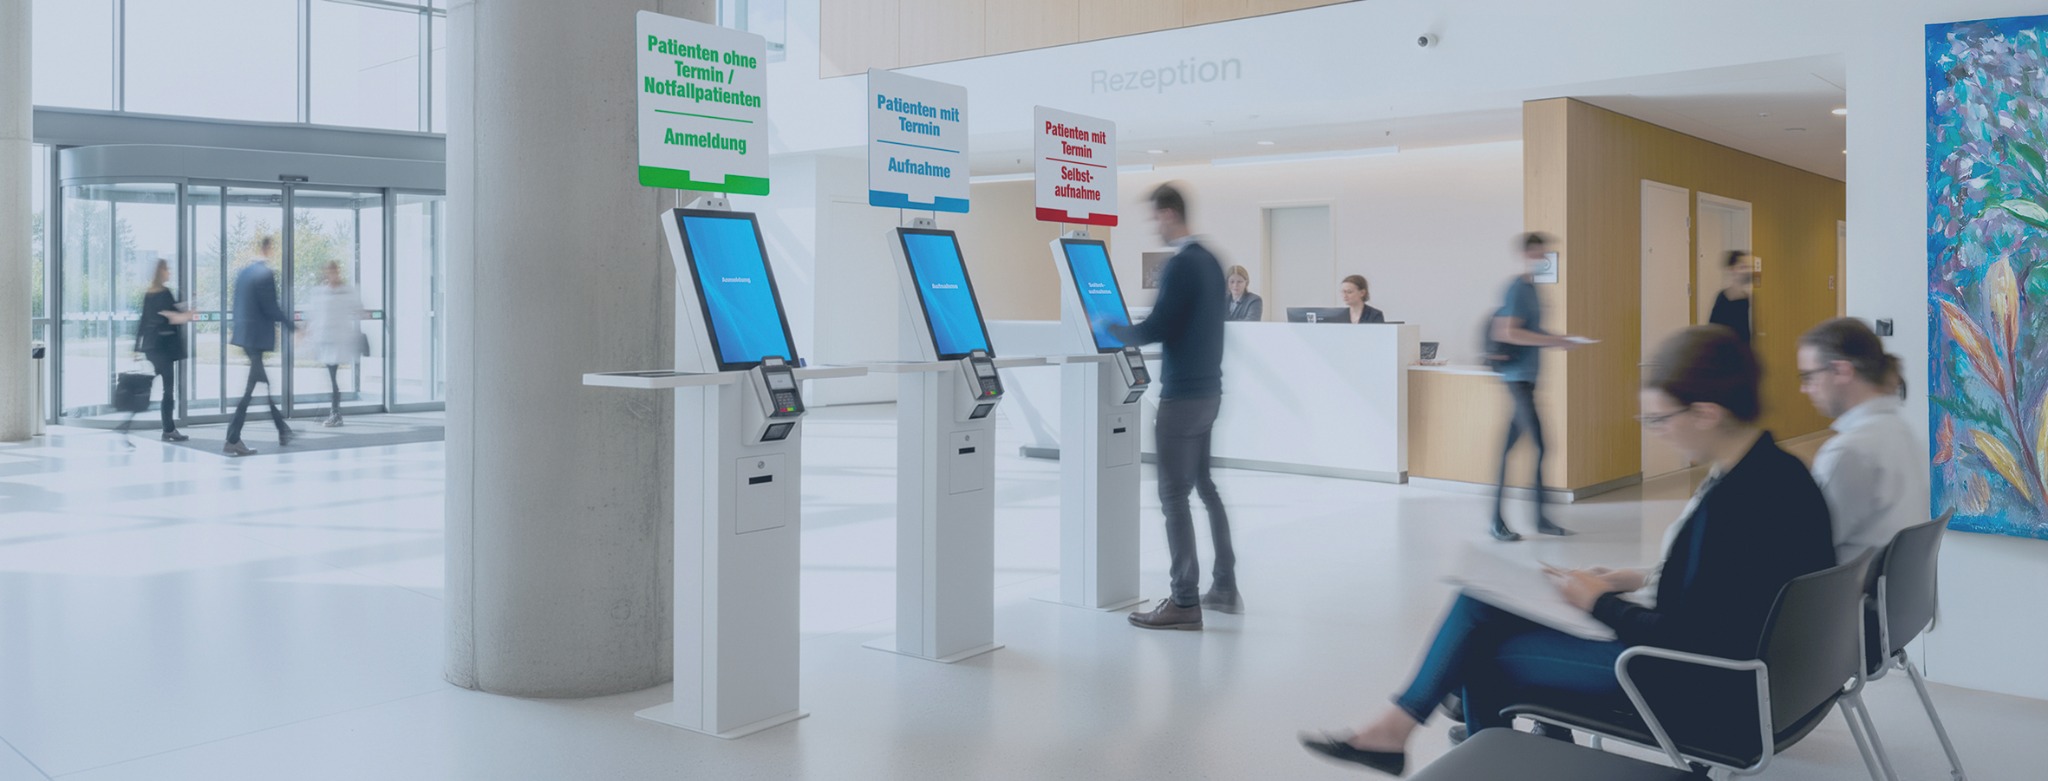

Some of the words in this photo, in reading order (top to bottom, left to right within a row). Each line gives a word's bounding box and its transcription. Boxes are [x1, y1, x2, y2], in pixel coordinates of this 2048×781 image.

[648, 35, 719, 63] Patienten
[723, 50, 757, 69] ohne
[674, 60, 724, 83] Termin
[728, 69, 735, 84] /
[1091, 57, 1241, 94] Rezeption
[644, 76, 761, 108] Notfallpatienten
[877, 94, 937, 118] Patienten
[940, 107, 960, 122] mit
[898, 116, 941, 136] Termin
[1045, 120, 1090, 142] Patienten
[1091, 131, 1107, 145] mit
[663, 127, 747, 155] Anmeldung
[1061, 140, 1093, 159] Termin
[888, 157, 951, 178] Aufnahme
[1061, 165, 1094, 183] Selbst-
[1054, 183, 1101, 201] aufnahme
